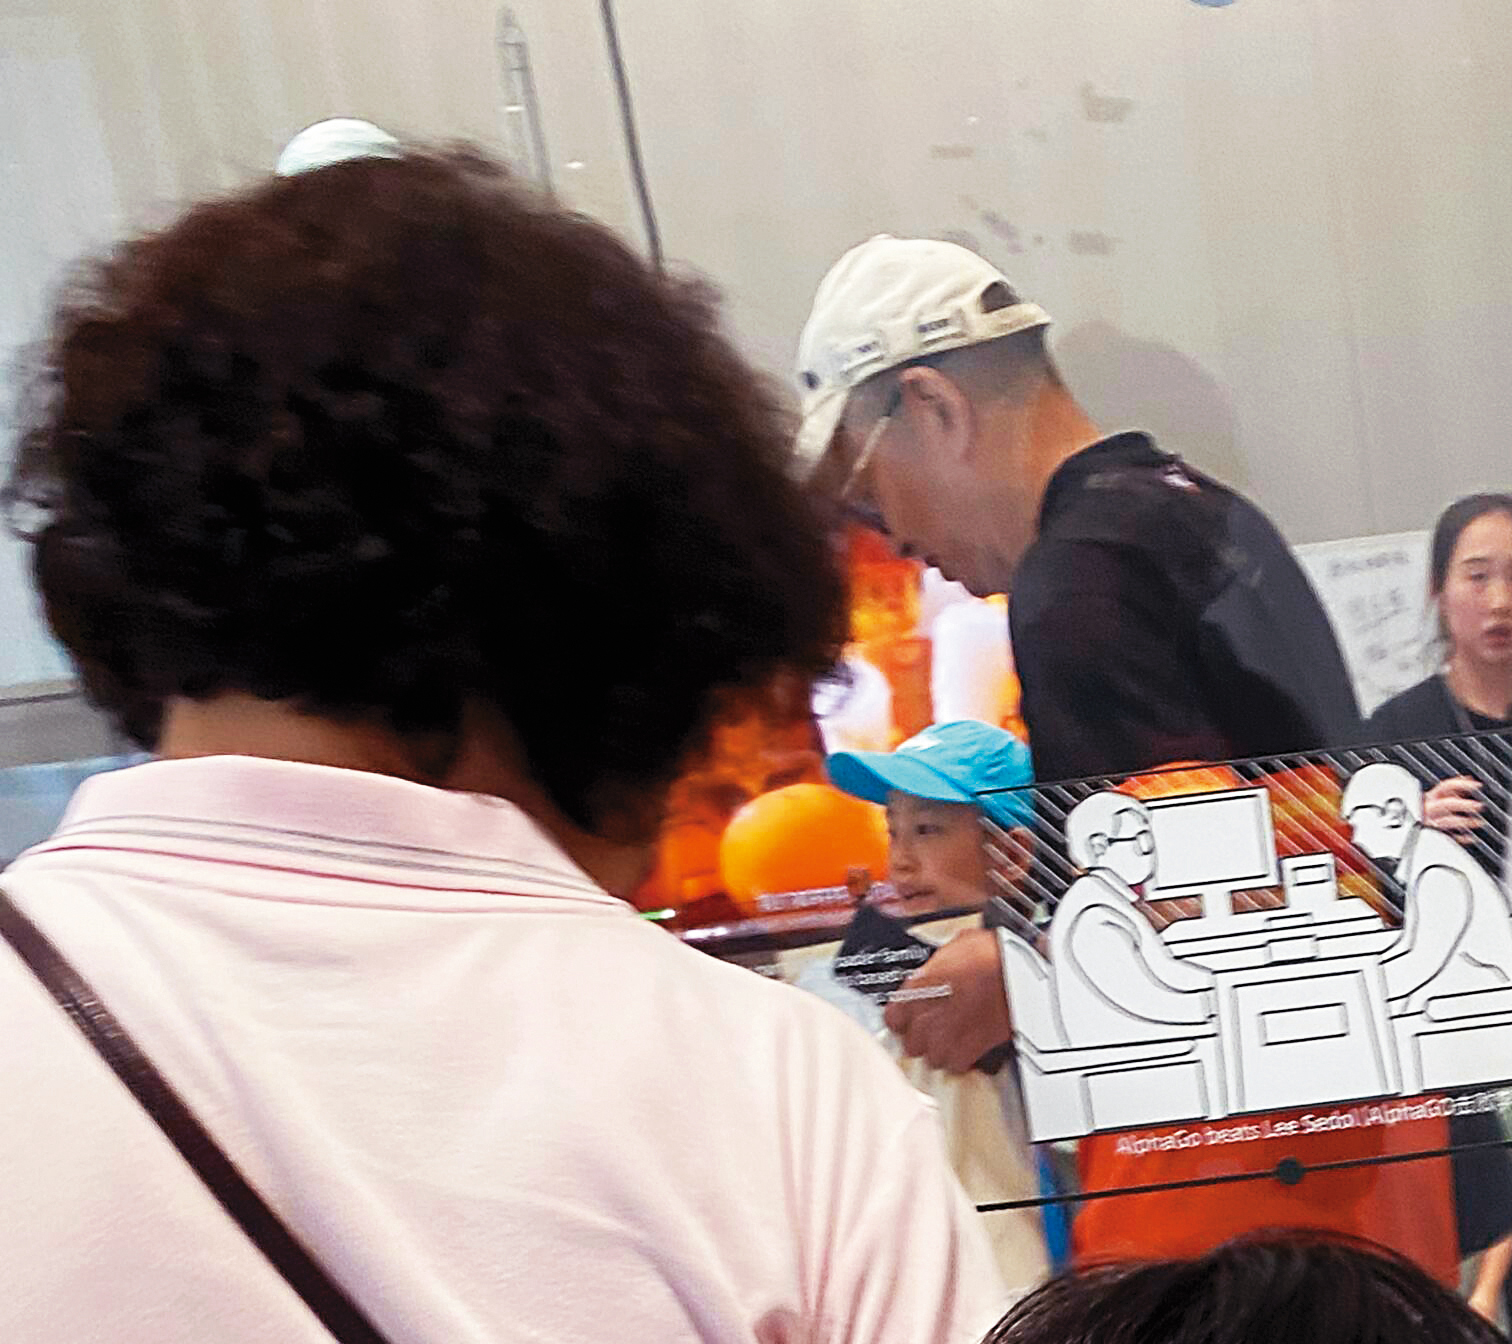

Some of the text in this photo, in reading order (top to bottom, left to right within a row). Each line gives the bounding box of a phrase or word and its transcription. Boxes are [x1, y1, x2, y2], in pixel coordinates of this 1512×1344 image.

[1115, 1129, 1201, 1157] AlphaGo
[1203, 1123, 1261, 1146] beats
[1261, 1118, 1300, 1139] Lee
